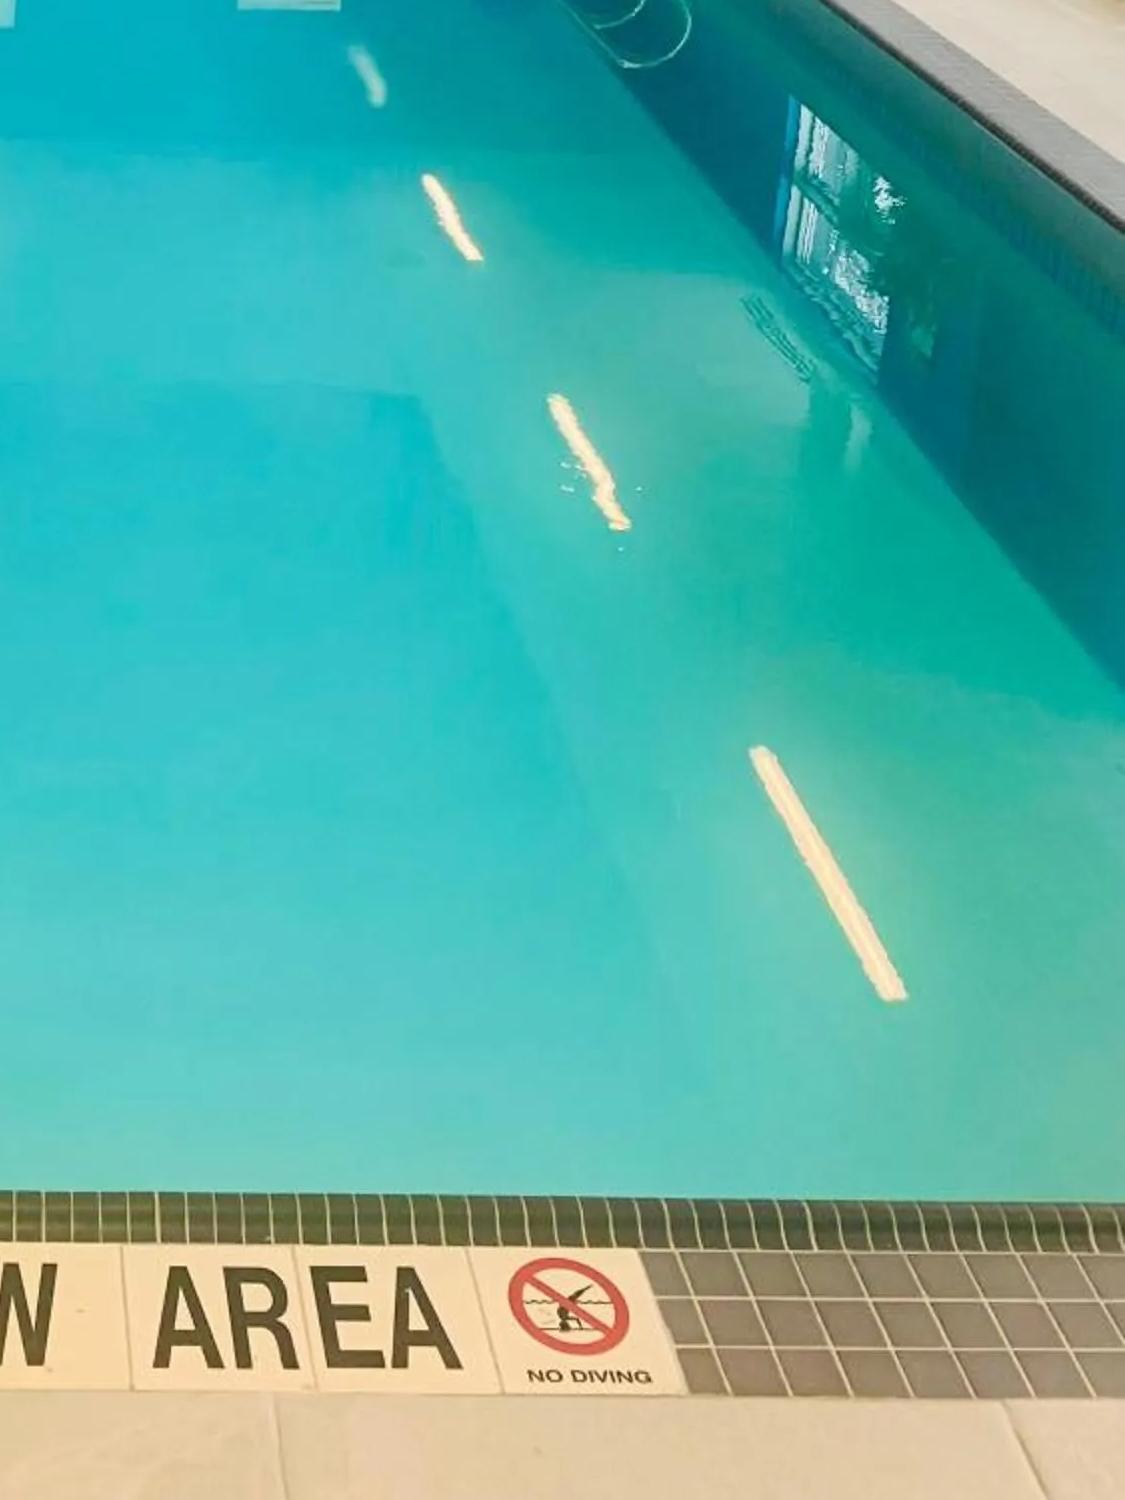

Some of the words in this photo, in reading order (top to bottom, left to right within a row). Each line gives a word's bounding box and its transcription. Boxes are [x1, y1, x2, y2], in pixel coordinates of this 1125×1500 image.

[152, 1265, 464, 1370] AREA
[526, 1369, 564, 1383] NO
[570, 1369, 653, 1384] DIVING
